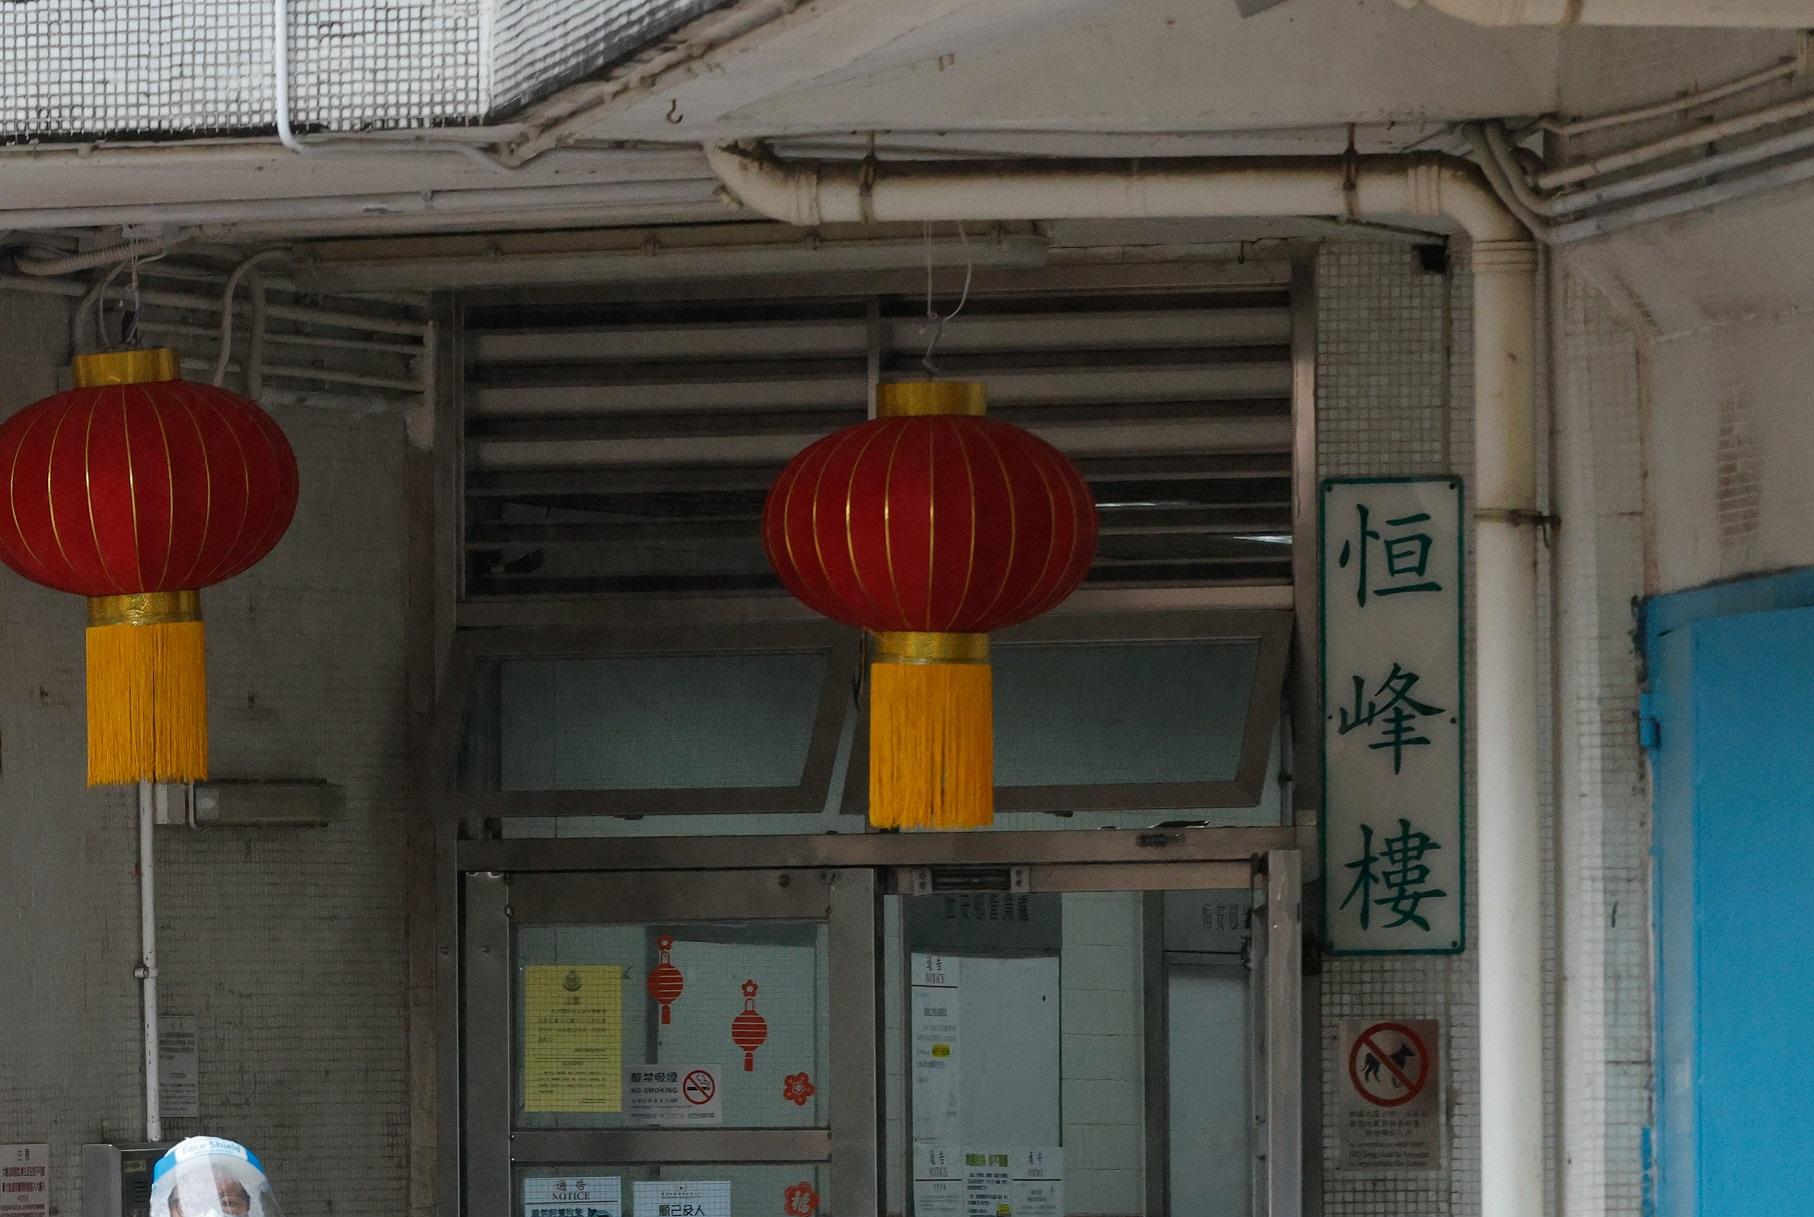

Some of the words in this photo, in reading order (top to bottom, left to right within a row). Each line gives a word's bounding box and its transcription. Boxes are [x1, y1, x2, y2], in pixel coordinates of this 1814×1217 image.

[1338, 503, 1447, 931] 恒峰樓
[552, 1191, 590, 1200] NOTICE
